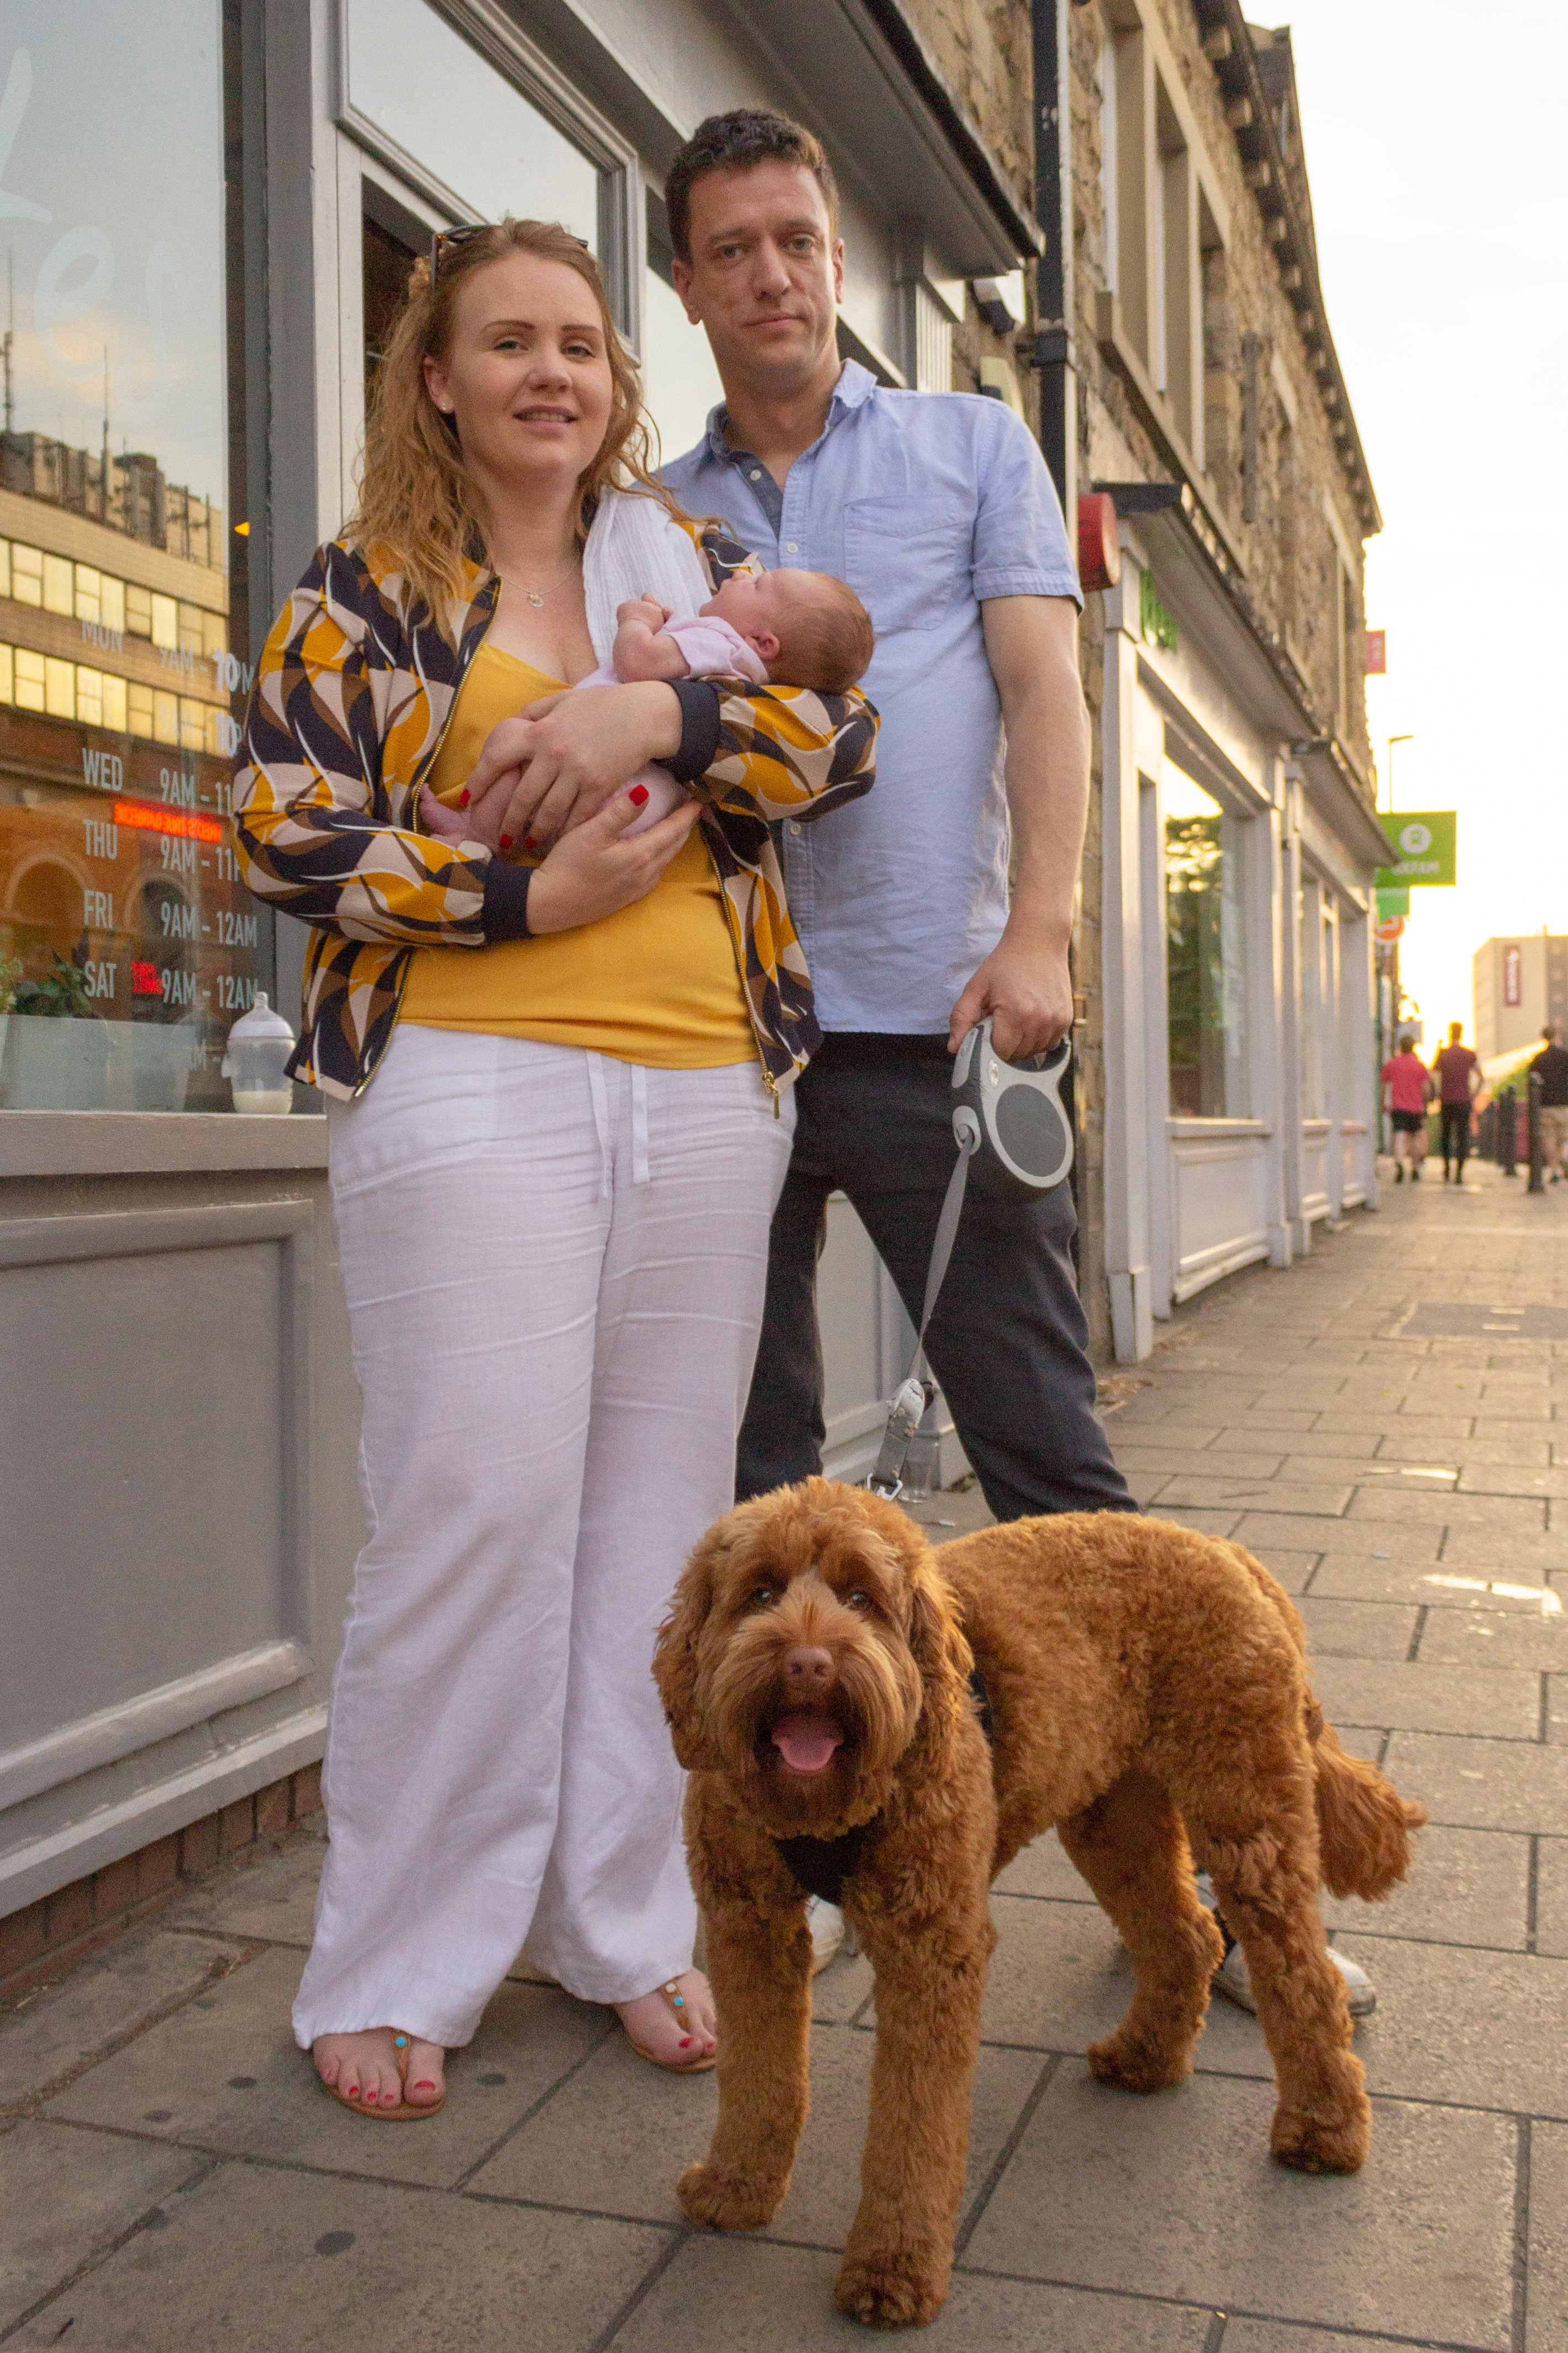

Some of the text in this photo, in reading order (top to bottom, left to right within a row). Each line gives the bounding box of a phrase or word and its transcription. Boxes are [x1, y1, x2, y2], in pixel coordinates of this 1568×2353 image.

[82, 748, 122, 791] WED
[160, 768, 195, 809] 9AM
[83, 819, 117, 860] THU
[160, 835, 196, 873] 9AM
[84, 889, 113, 929] FRI
[161, 901, 197, 940] 9AM
[216, 910, 257, 948] 12AM
[84, 961, 117, 998] SAT
[162, 969, 196, 1004] 9AM
[216, 975, 259, 1010] 12AM
